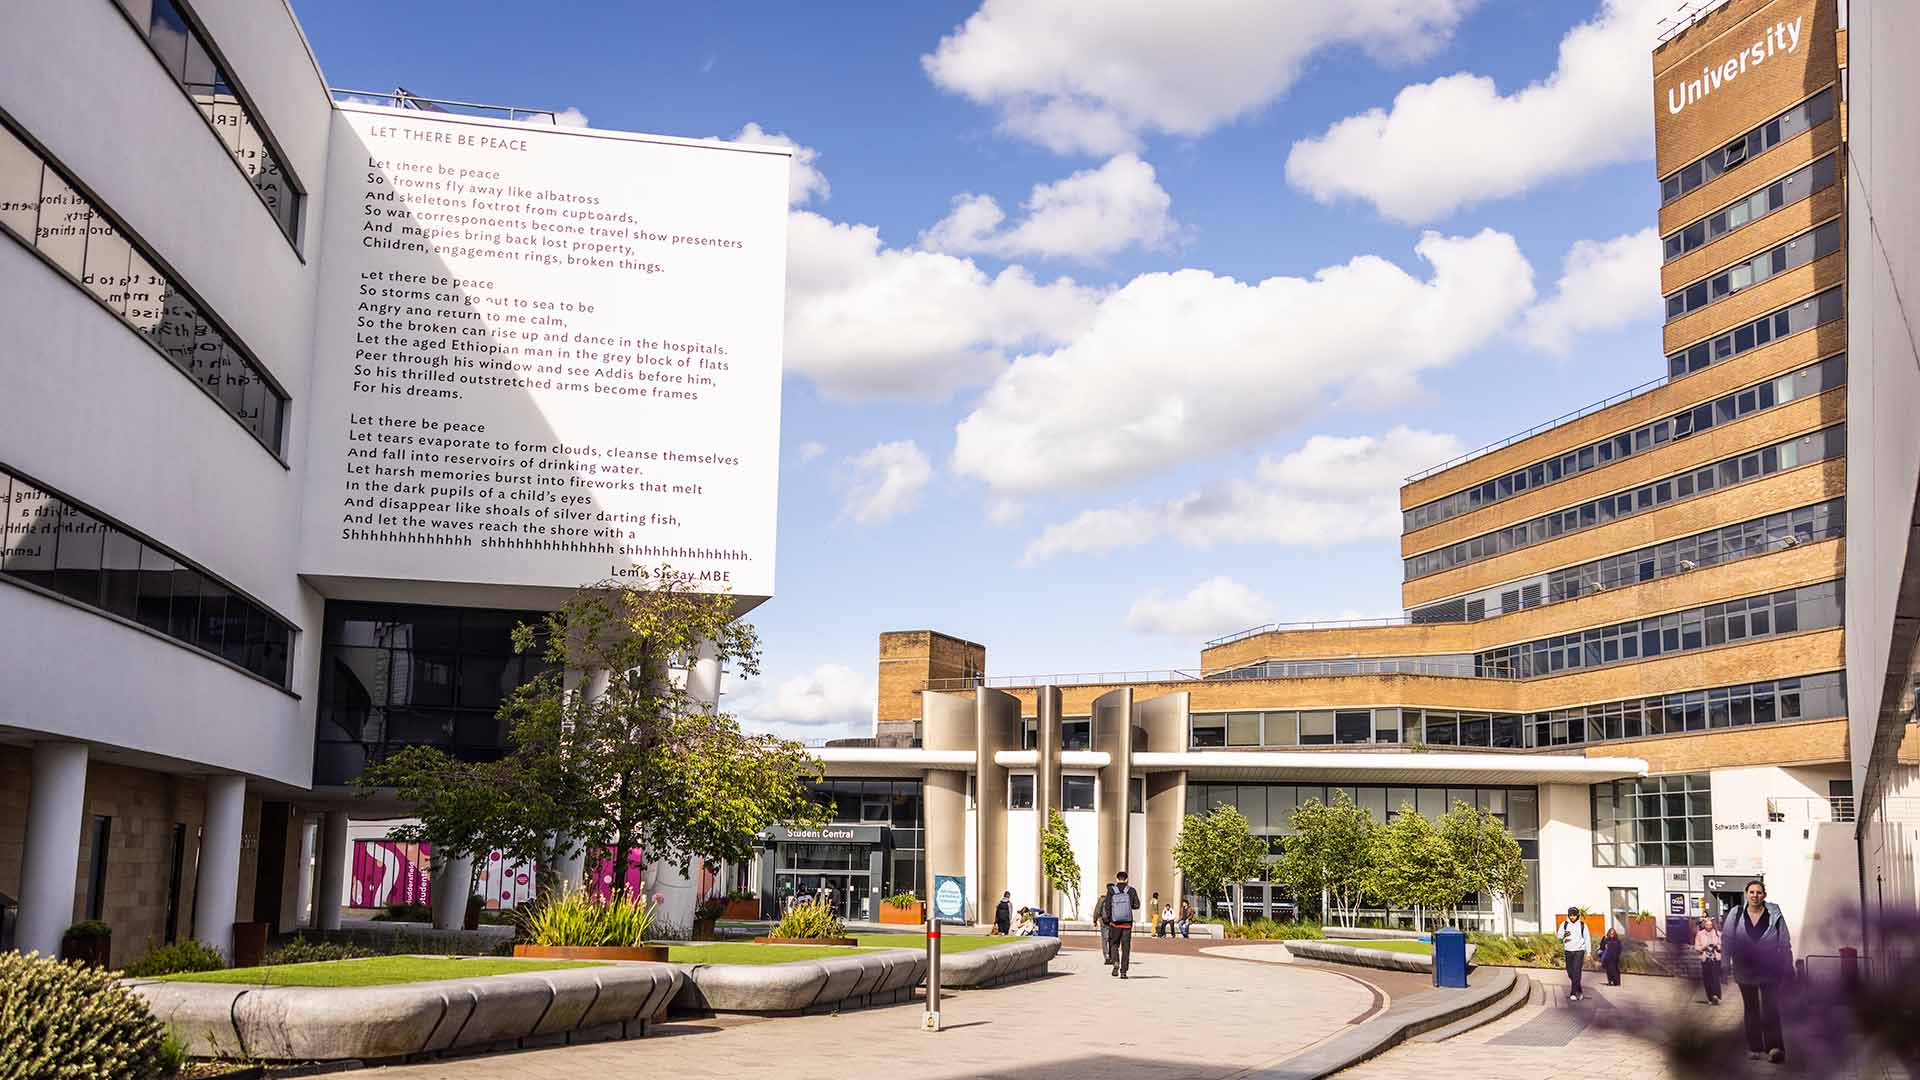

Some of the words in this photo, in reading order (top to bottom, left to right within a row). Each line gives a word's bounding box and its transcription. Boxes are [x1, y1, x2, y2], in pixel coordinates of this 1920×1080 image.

[1668, 16, 1802, 114] University
[371, 126, 397, 138] LET
[404, 129, 451, 144] THERE
[458, 134, 474, 146] BE
[481, 137, 526, 152] PEACE
[438, 164, 454, 175] be
[460, 169, 500, 180] peace
[368, 172, 384, 184] So
[446, 180, 464, 194] fly
[508, 186, 532, 198] like
[536, 190, 600, 205] albatross
[365, 191, 394, 201] And
[526, 203, 557, 216] from
[363, 221, 392, 233] And
[402, 226, 460, 239] magpies
[465, 230, 501, 245] bring
[506, 233, 537, 246] back
[542, 236, 567, 248] lost
[364, 204, 381, 216] So
[386, 210, 411, 218] war
[590, 227, 628, 238] travel
[633, 230, 667, 241] show
[672, 236, 743, 249] presenters
[434, 246, 519, 260] engagement
[567, 254, 614, 267] broken
[432, 275, 448, 286] be
[453, 279, 494, 289] peace
[360, 284, 376, 296] So
[382, 288, 430, 300] storms
[435, 293, 459, 302] can
[464, 296, 480, 306] go
[514, 299, 528, 308] to
[533, 301, 554, 310] sea
[560, 302, 574, 311] to
[578, 302, 594, 313] be
[358, 302, 401, 316] Angry
[488, 313, 500, 322] to
[506, 315, 526, 324] me
[357, 316, 374, 328] So
[380, 318, 402, 330] the
[408, 320, 456, 334] broken
[462, 327, 486, 336] can
[492, 328, 516, 338] rise
[522, 332, 538, 342] up
[544, 332, 568, 342] and
[574, 333, 614, 346] dance
[620, 337, 631, 347] in
[637, 338, 658, 350] the
[357, 332, 379, 344] Let
[385, 334, 408, 346] the
[412, 338, 446, 351] aged
[452, 339, 518, 356] Ethiopian
[524, 348, 552, 357] man
[558, 348, 570, 358] in
[576, 349, 598, 360] the
[603, 353, 631, 365] grey
[636, 353, 672, 366] block
[677, 357, 690, 367] of
[700, 358, 728, 370] flats
[356, 349, 387, 361] Peer
[392, 352, 448, 368] through
[454, 356, 474, 368] his
[479, 359, 532, 371] window
[537, 364, 562, 374] and
[568, 368, 589, 376] see
[594, 368, 634, 380] Addis
[639, 370, 682, 383] before
[354, 364, 371, 376] So
[376, 366, 397, 378] his
[402, 368, 455, 382] thrilled
[460, 376, 551, 389] outstretched
[556, 382, 589, 392] arms
[594, 382, 647, 396] become
[652, 386, 698, 400] frames
[354, 381, 376, 392] For
[381, 382, 401, 395] his
[350, 413, 373, 426] Let
[378, 416, 416, 428] there
[422, 418, 438, 430] be
[444, 423, 485, 432] peace
[347, 448, 377, 458] And
[383, 448, 406, 460] fall
[411, 450, 439, 462] into
[444, 455, 515, 467] reservoirs
[520, 457, 534, 468] of
[538, 458, 596, 474] drinking
[350, 430, 372, 442] Let
[378, 433, 414, 444] tears
[418, 437, 490, 450] evaporate
[496, 441, 509, 450] to
[514, 440, 546, 453] form
[606, 448, 658, 460] cleanse
[663, 451, 738, 466] themselves
[347, 462, 370, 474] Let
[375, 464, 414, 477] harsh
[420, 470, 490, 482] memories
[495, 472, 532, 484] burst
[537, 474, 565, 486] into
[570, 476, 634, 490] fireworks
[640, 481, 666, 492] that
[672, 484, 702, 494] melt
[346, 481, 359, 490] In
[365, 480, 388, 492] the
[394, 482, 425, 494] dark
[430, 486, 474, 498] pupils
[479, 487, 494, 498] of
[498, 491, 505, 499] a
[561, 496, 591, 506] eyes
[344, 496, 374, 508] And
[379, 497, 450, 513] disappear
[456, 502, 480, 514] like
[486, 504, 530, 517] shoals
[535, 506, 549, 518] of
[554, 508, 592, 520] silver
[596, 511, 646, 526] darting
[343, 513, 373, 524] And
[378, 513, 397, 526] let
[402, 515, 426, 527] the
[431, 520, 474, 530] waves
[479, 521, 518, 532] reach
[523, 522, 546, 534] the
[550, 524, 588, 536] shore
[594, 527, 623, 538] with
[700, 570, 730, 582] MBE
[787, 829, 820, 838] Student
[822, 830, 854, 838] Central
